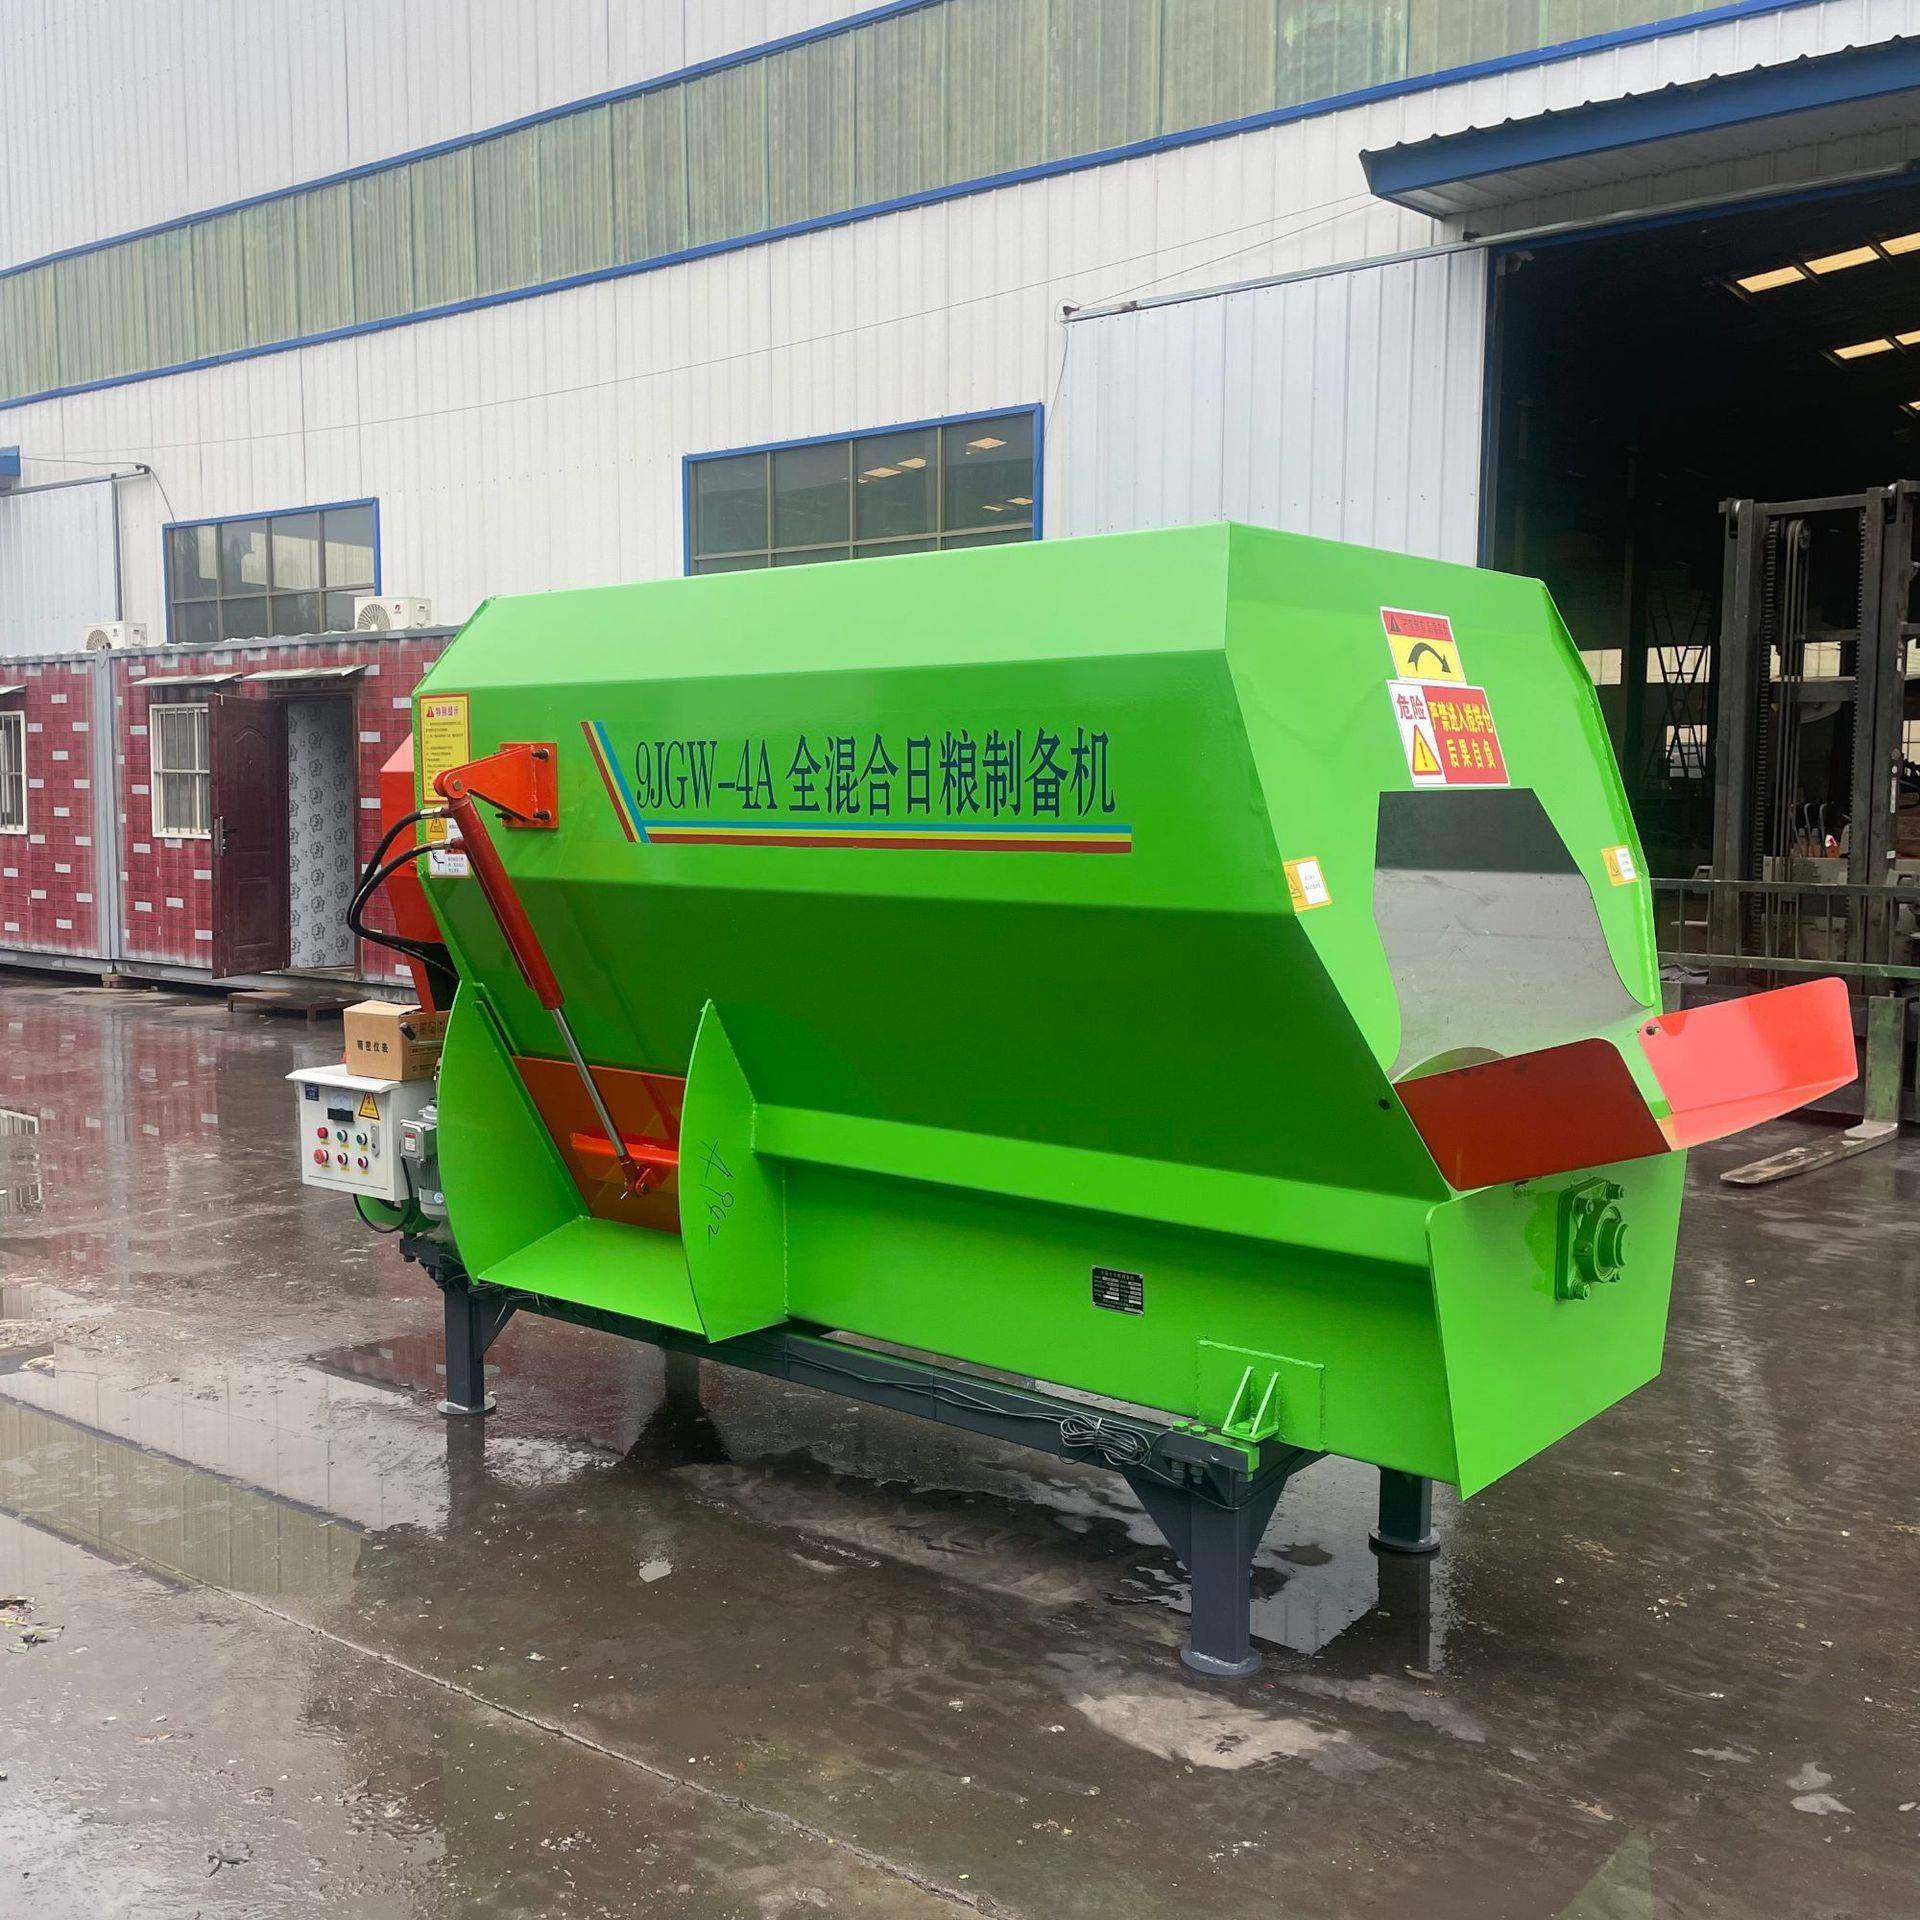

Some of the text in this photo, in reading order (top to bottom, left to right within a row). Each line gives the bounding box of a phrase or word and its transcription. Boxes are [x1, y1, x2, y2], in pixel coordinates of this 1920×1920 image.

[1396, 694, 1426, 720] 危险
[1447, 738, 1497, 769] 后果自负
[635, 728, 1115, 817] 9JGW-4A 全混合日粮制备机
